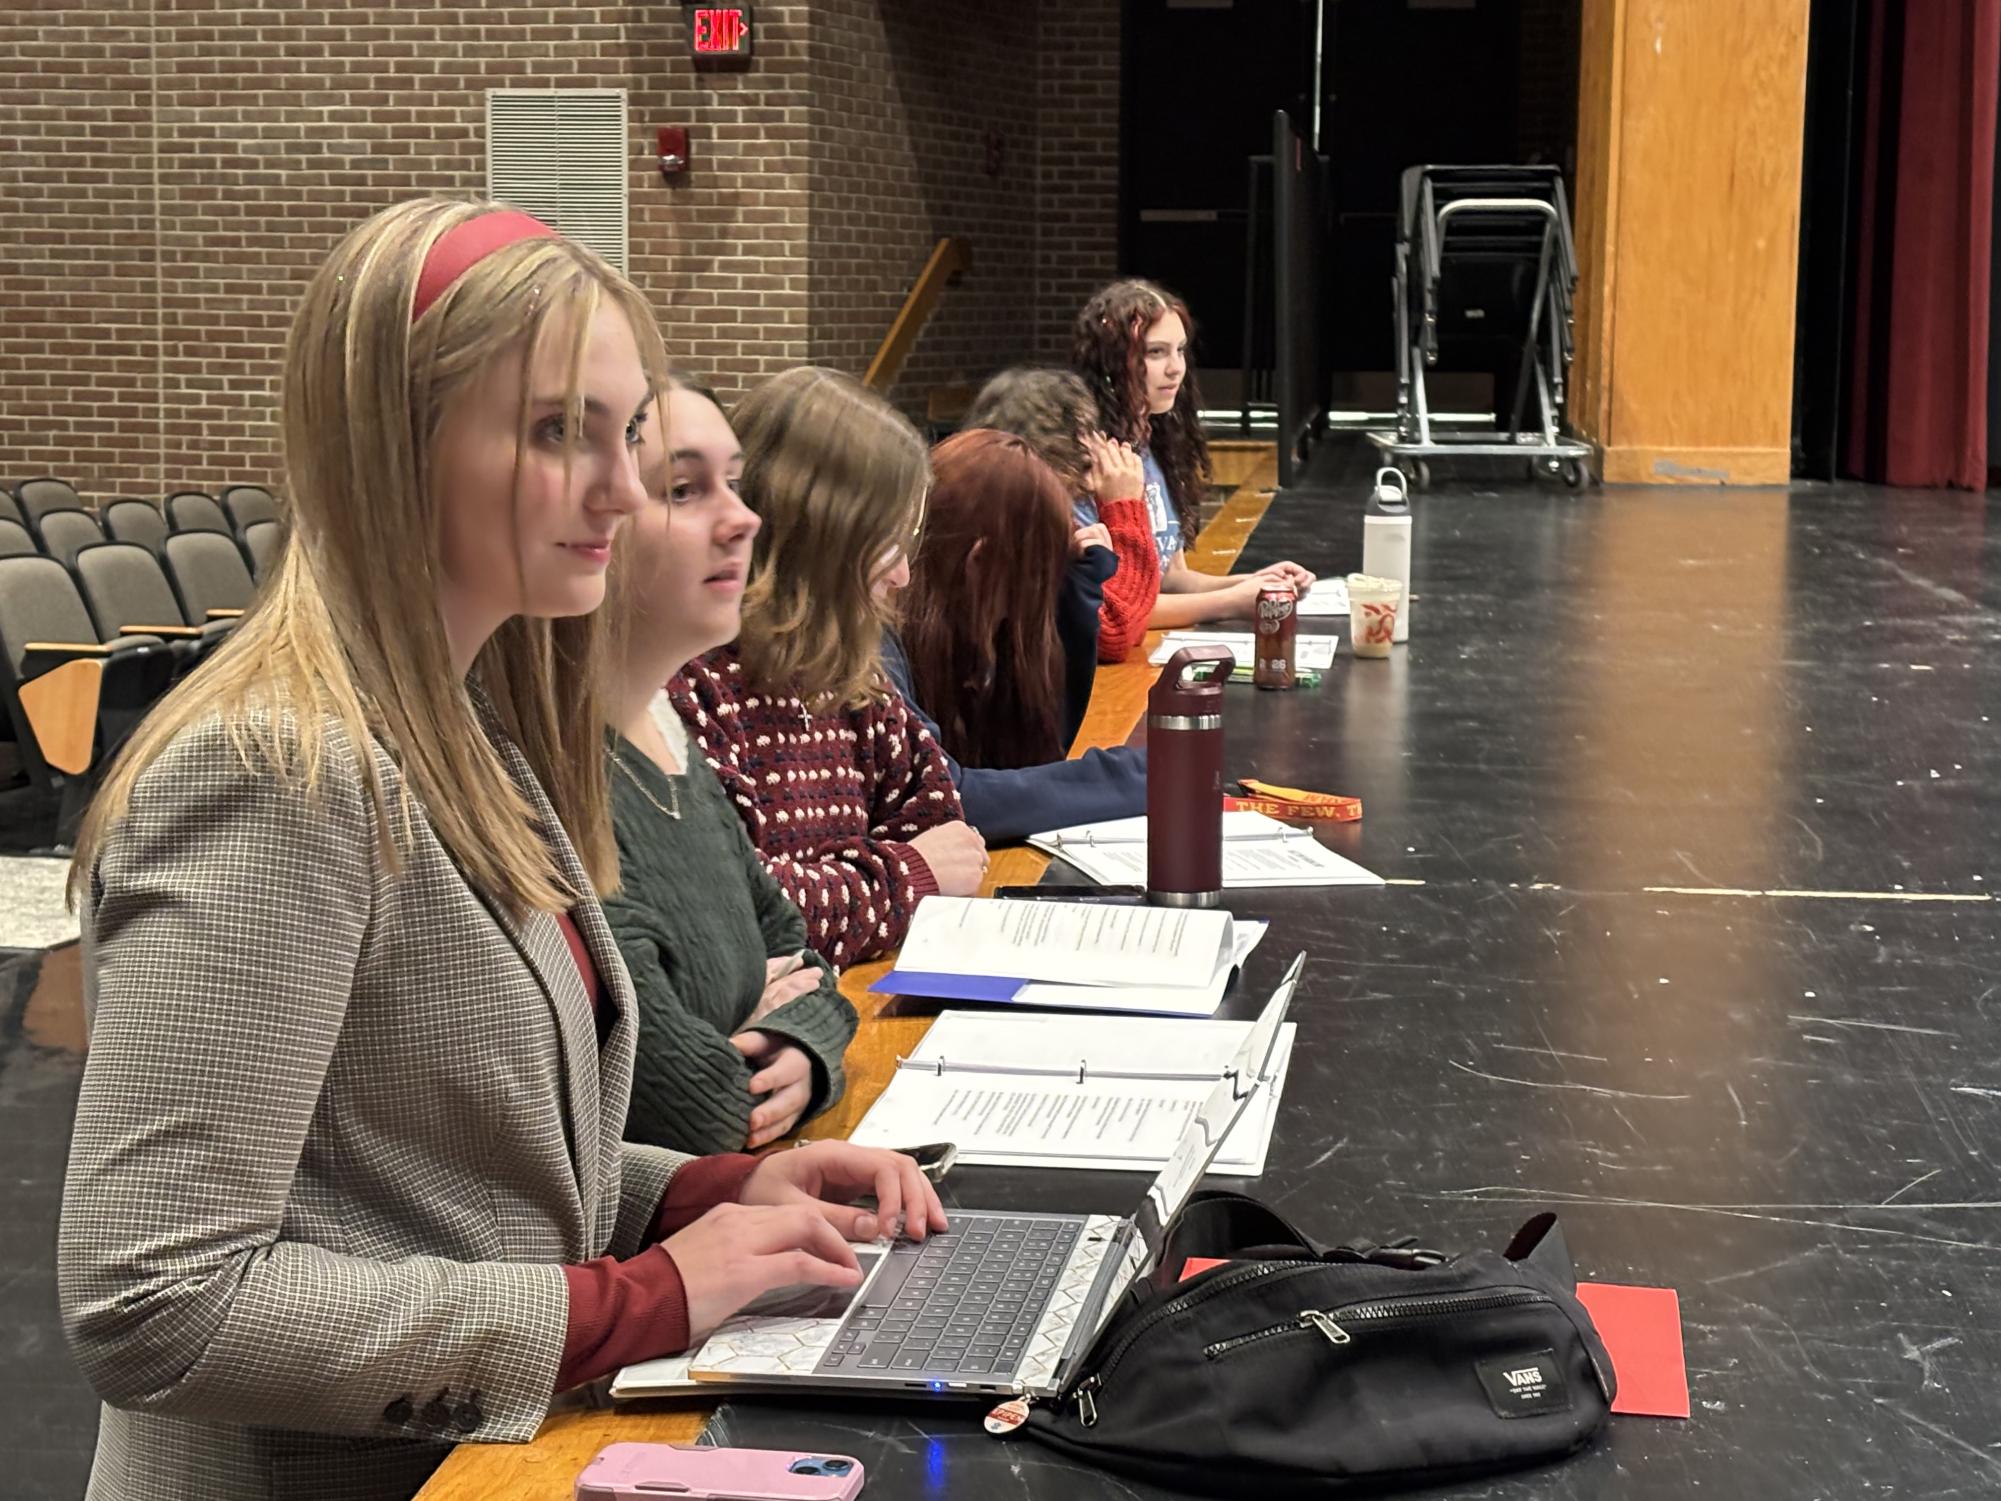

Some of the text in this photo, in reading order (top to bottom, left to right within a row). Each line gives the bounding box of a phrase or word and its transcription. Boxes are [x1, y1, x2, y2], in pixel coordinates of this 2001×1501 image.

[695, 9, 742, 52] EXIT
[1236, 800, 1279, 815] THE
[1287, 804, 1340, 818] FEW.
[1503, 1367, 1542, 1387] VANS
